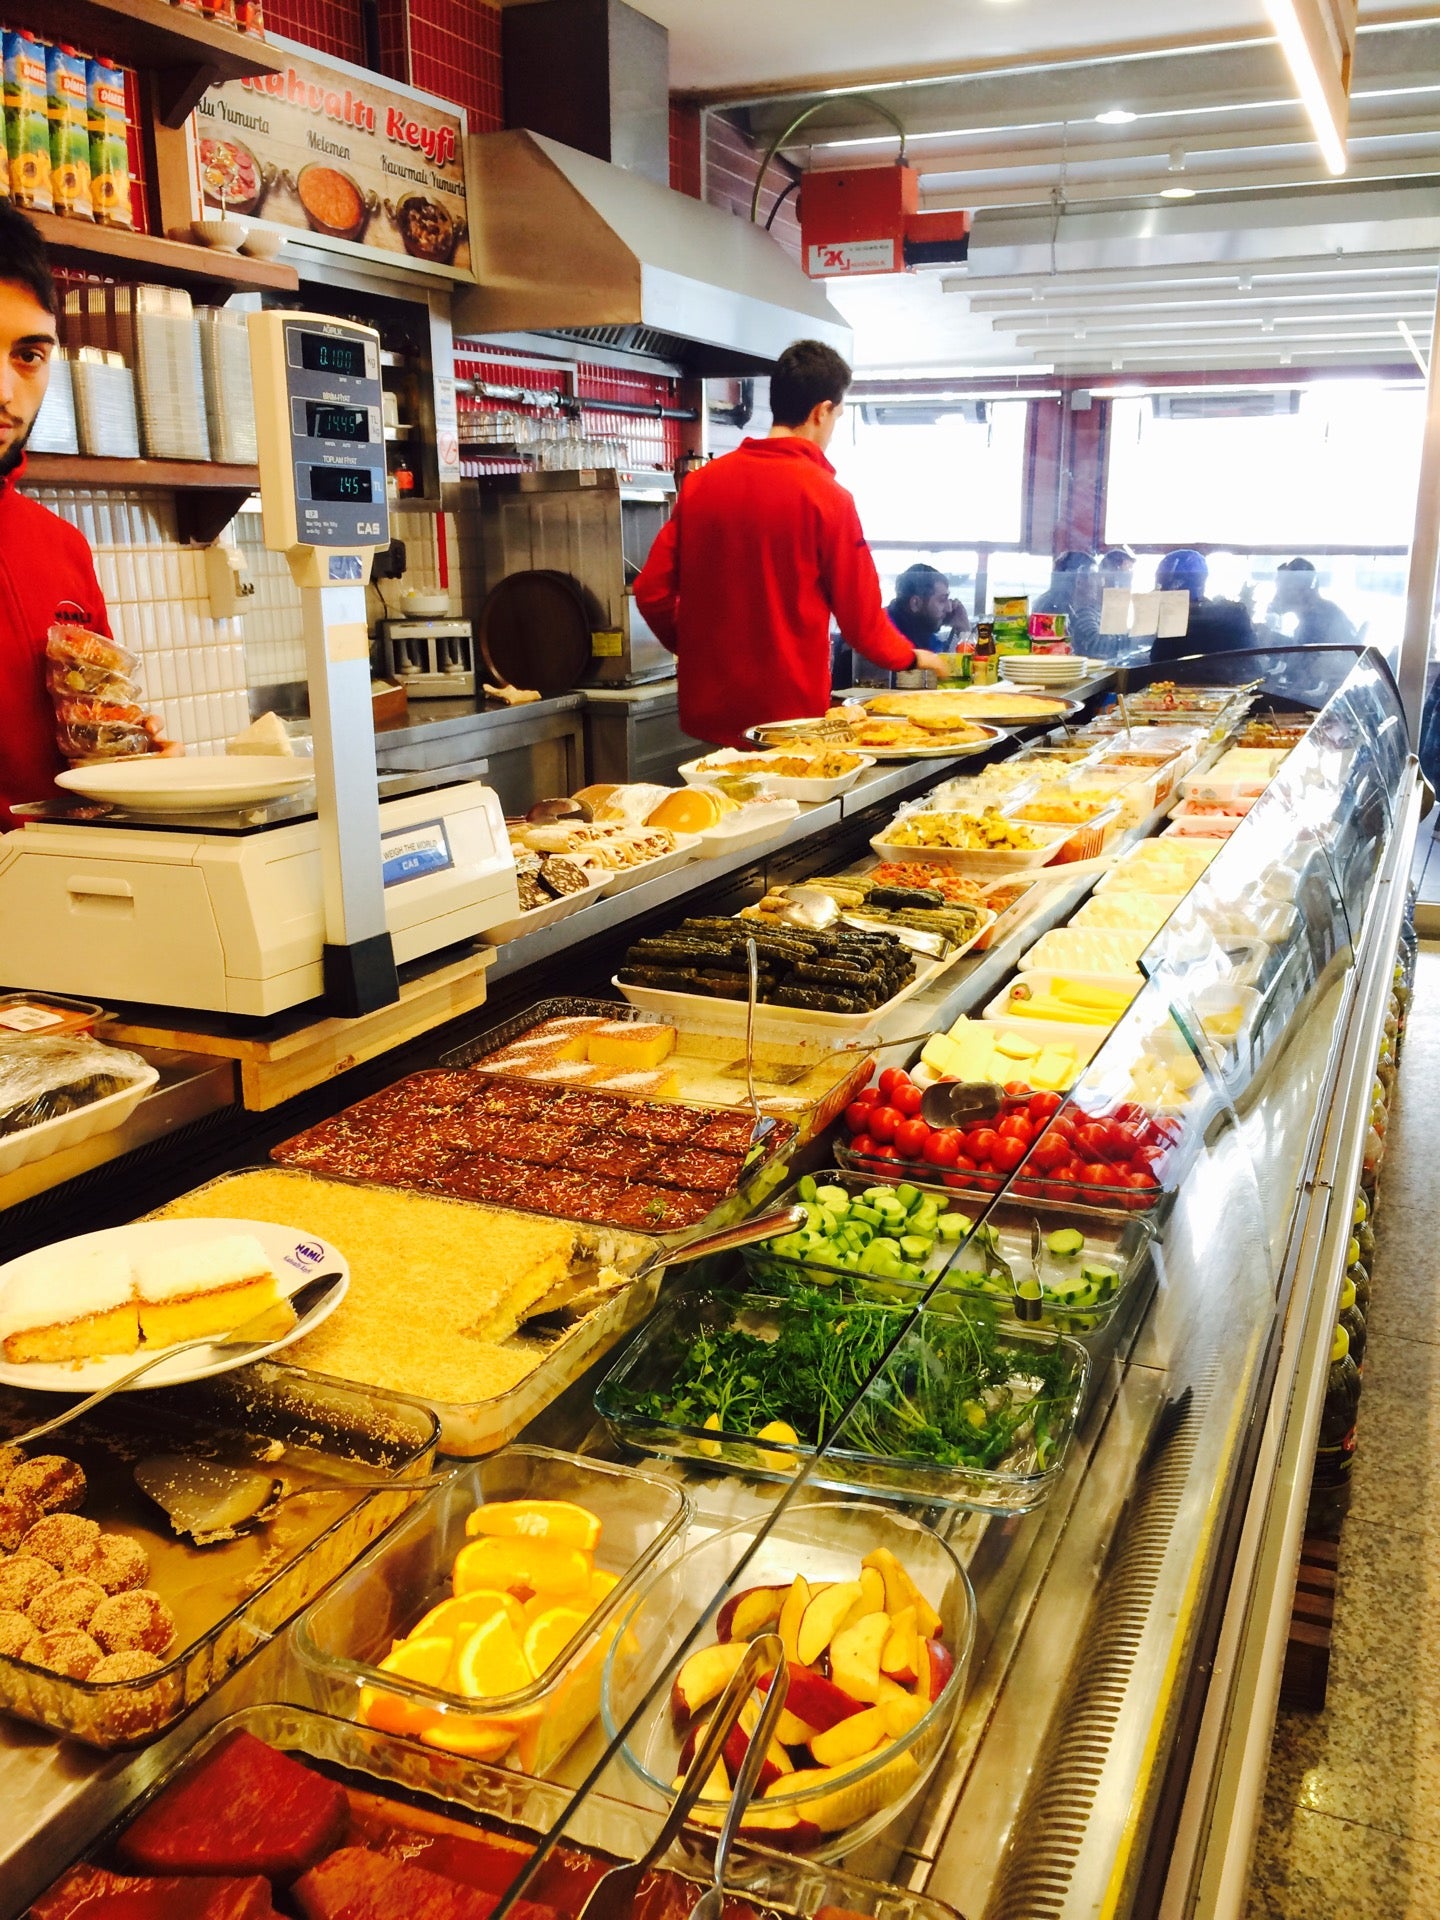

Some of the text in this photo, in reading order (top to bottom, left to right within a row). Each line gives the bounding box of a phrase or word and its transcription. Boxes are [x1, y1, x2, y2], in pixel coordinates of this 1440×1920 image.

[217, 100, 269, 134] Yumurta
[385, 106, 455, 167] Keyfi
[823, 250, 845, 267] 2K
[373, 480, 383, 493] TL
[356, 522, 381, 536] CAS
[384, 847, 403, 860] WEIGH
[404, 843, 416, 852] THE
[402, 858, 419, 870] CAS
[295, 1243, 325, 1263] NAMLI
